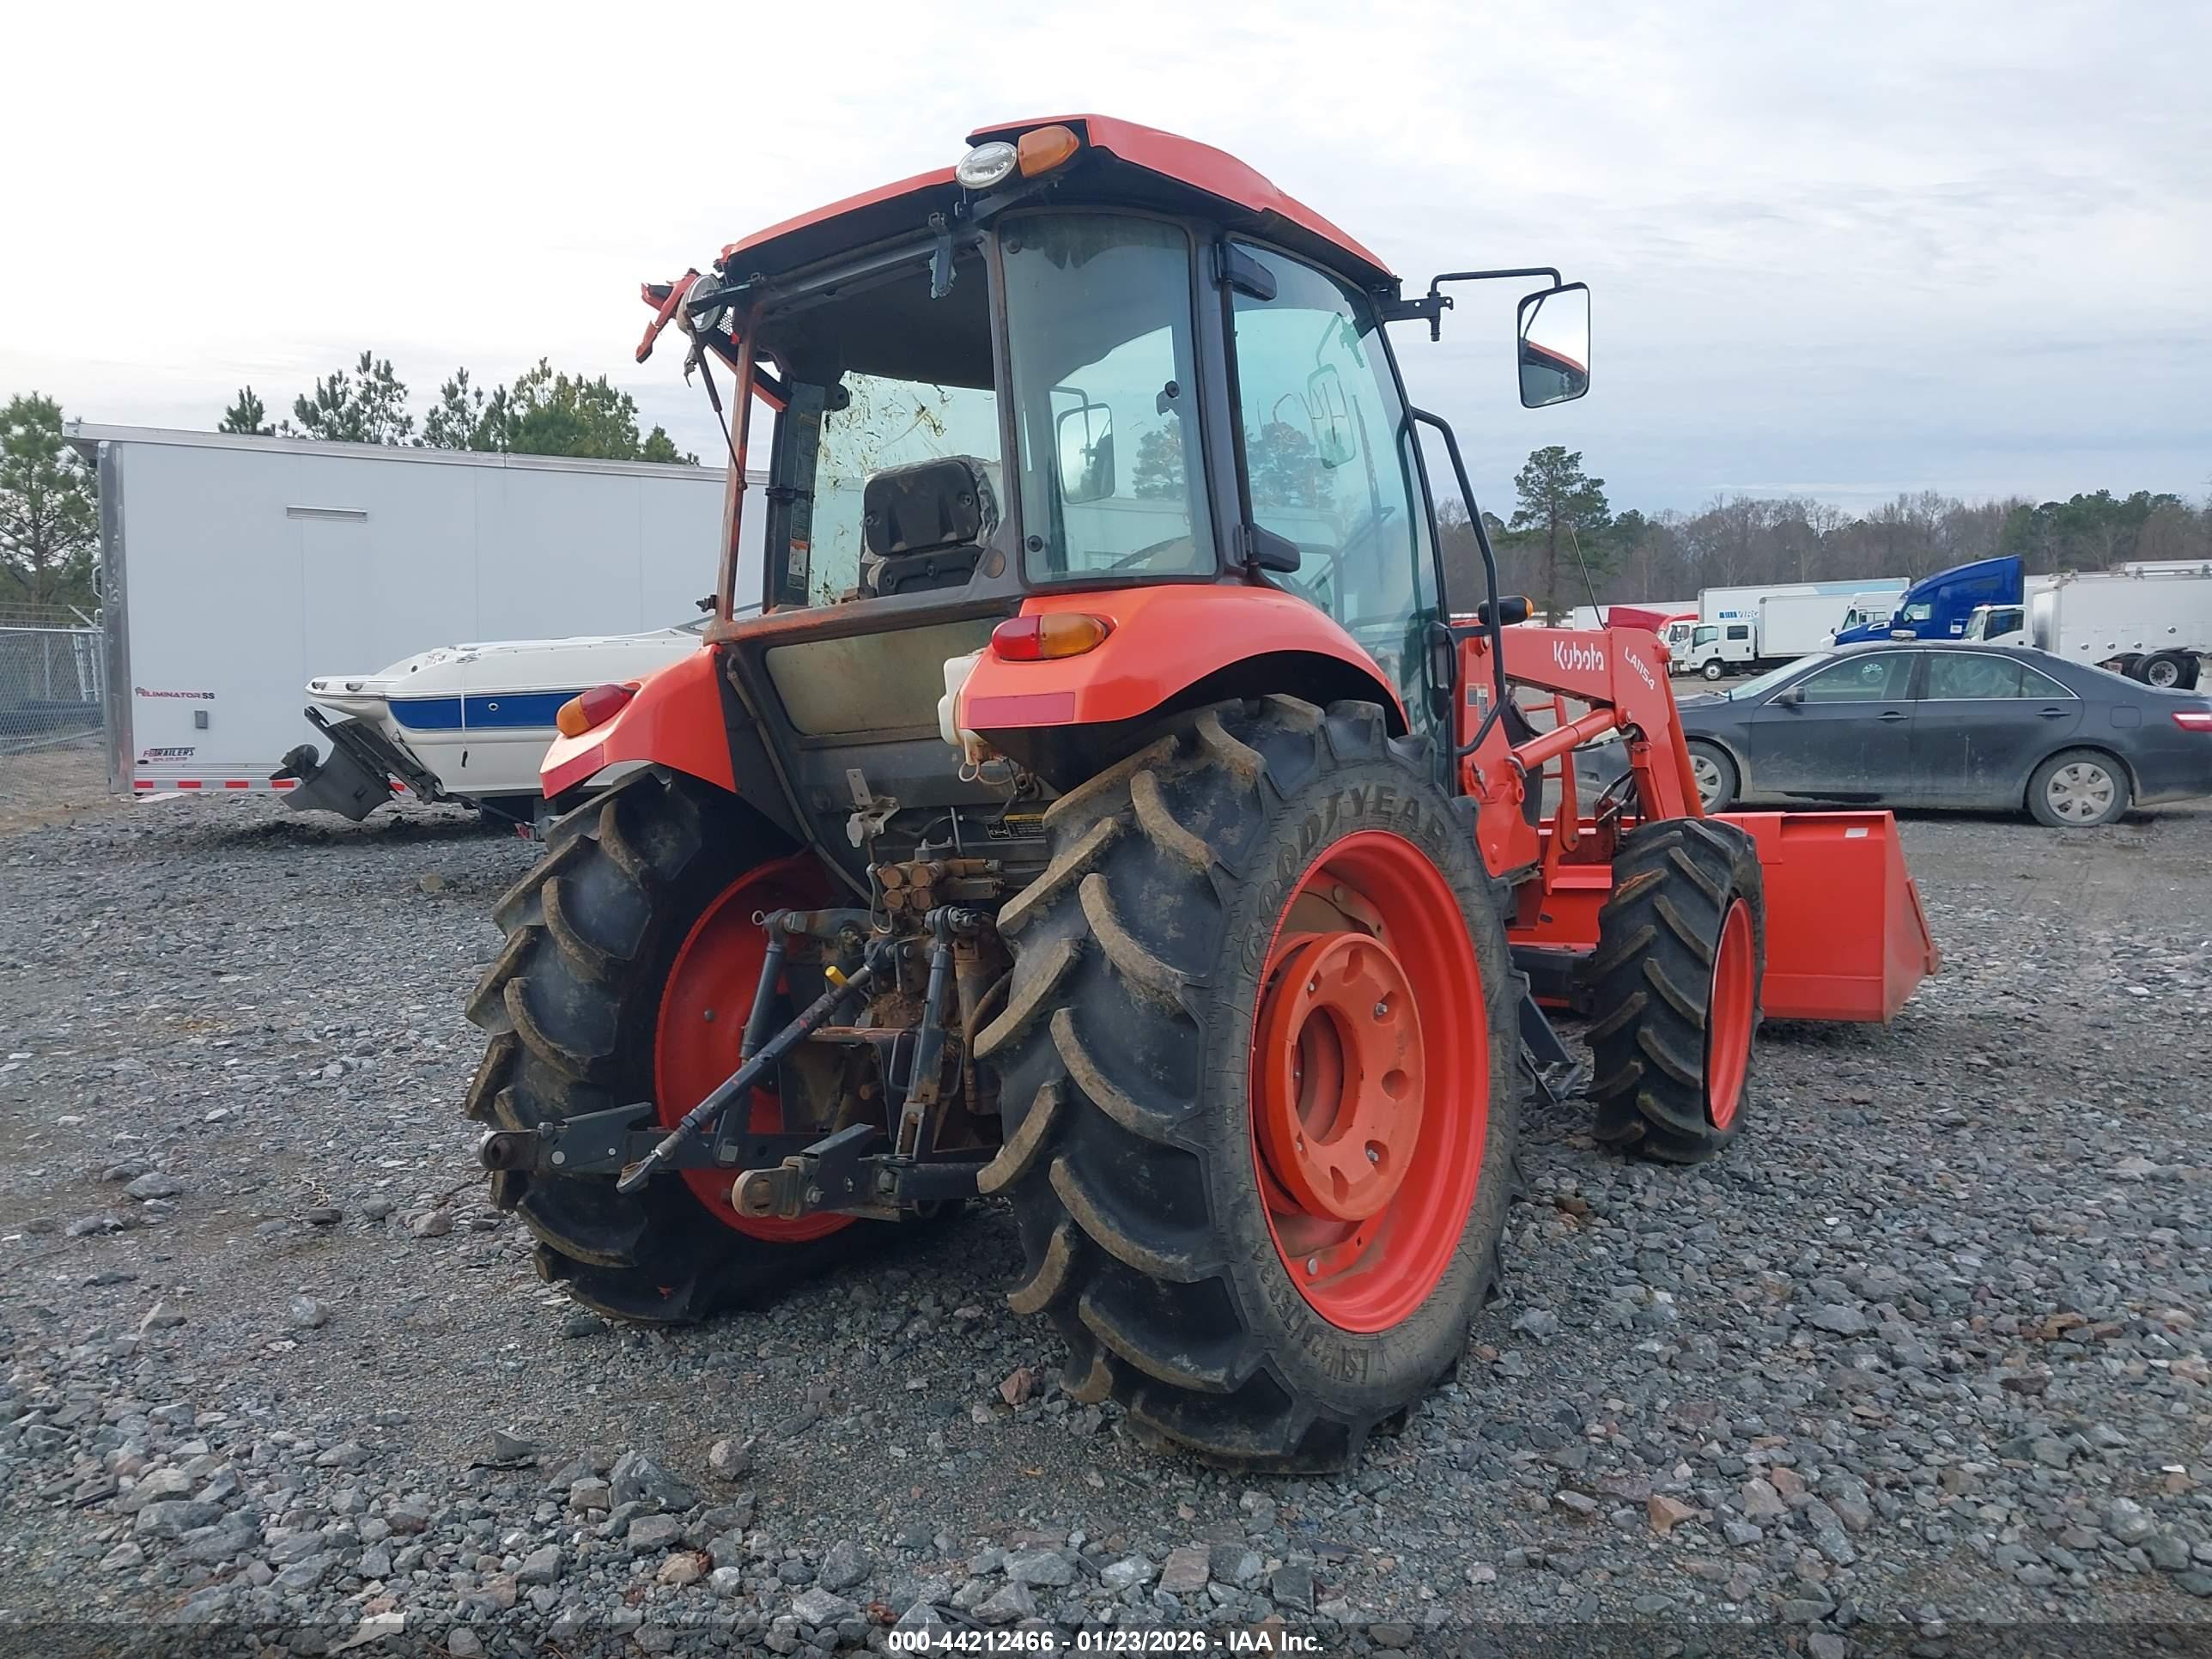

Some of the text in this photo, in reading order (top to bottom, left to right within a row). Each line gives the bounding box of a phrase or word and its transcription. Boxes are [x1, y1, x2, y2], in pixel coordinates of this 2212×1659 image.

[1553, 641, 1605, 672] Kubota
[1624, 646, 1656, 690] LA1154
[141, 690, 201, 699] ELIMINATOR
